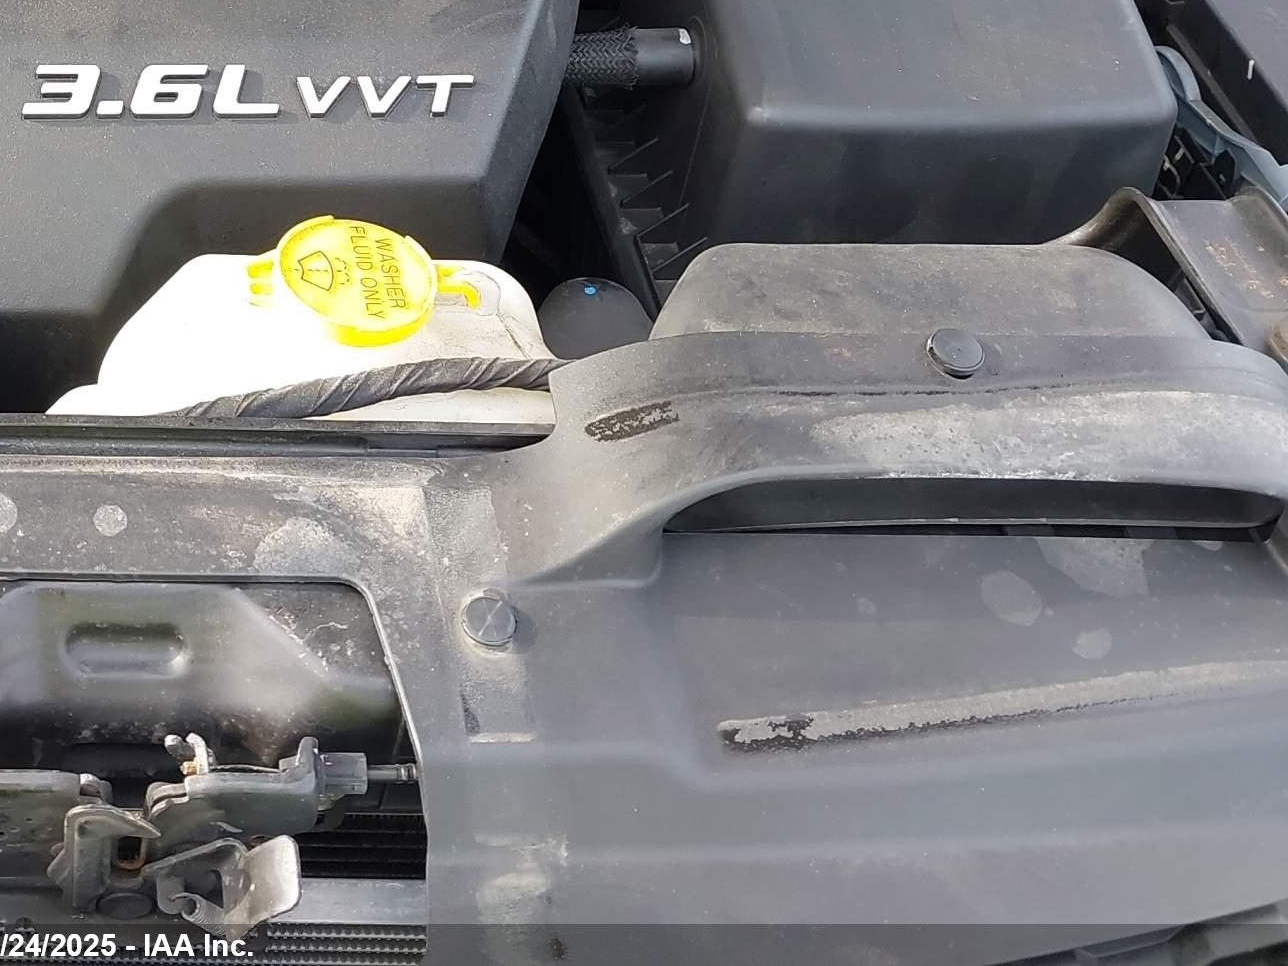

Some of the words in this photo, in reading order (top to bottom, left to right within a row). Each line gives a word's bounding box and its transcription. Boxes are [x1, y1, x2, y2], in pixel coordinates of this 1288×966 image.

[21, 64, 280, 120] 3.6L
[296, 74, 475, 119] VVT
[349, 225, 374, 271] FLUID
[374, 237, 407, 309] WASHER
[360, 277, 385, 320] ONLY
